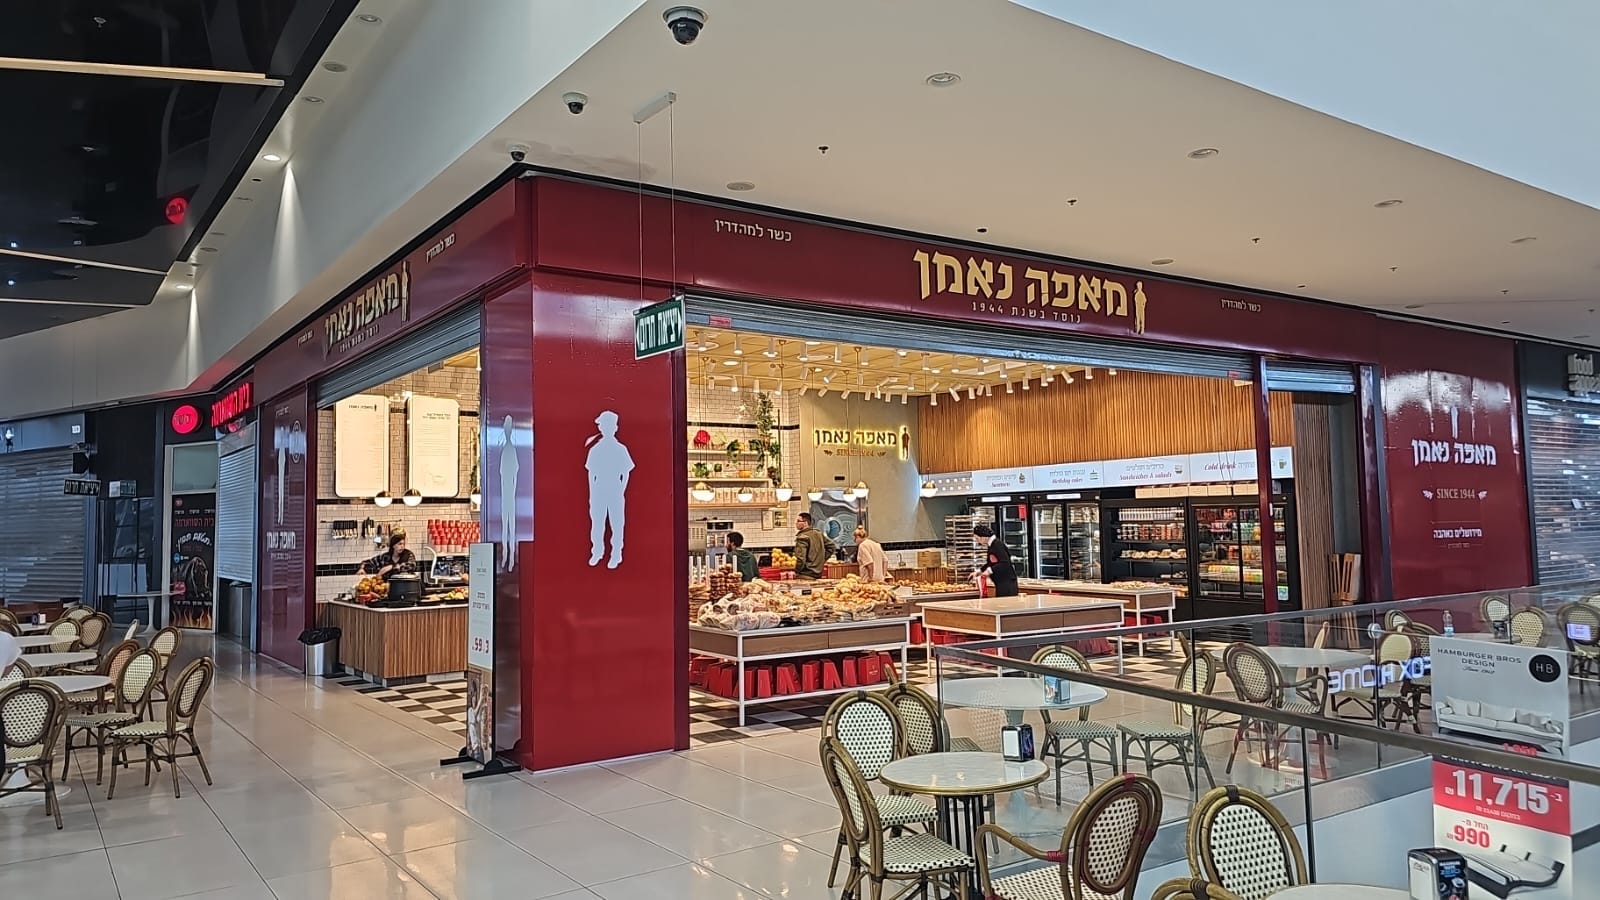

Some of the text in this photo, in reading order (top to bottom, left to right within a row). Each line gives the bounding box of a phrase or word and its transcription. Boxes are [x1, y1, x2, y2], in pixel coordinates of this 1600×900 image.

[715, 219, 792, 242] כשר למהדרין
[913, 249, 1128, 317] מאפה נאמן
[322, 272, 400, 361] מאפה נאמן
[972, 301, 1081, 324] נוסד בשנת 1944
[1247, 303, 1261, 312] כשר
[658, 307, 678, 346] יציאת
[815, 429, 897, 448] מאפה נאמן
[1411, 439, 1497, 467] מאפה נאמן
[1204, 463, 1219, 471] Cold
[1436, 488, 1475, 499] SINCE 1944
[1433, 527, 1482, 539] מירושלים באהבה
[1437, 648, 1522, 664] HAMBURGER BROS
[1461, 658, 1495, 668] DESIGN
[1452, 769, 1549, 815] 11,715
[1453, 824, 1491, 848] 990
[1473, 821, 1489, 831] החל
